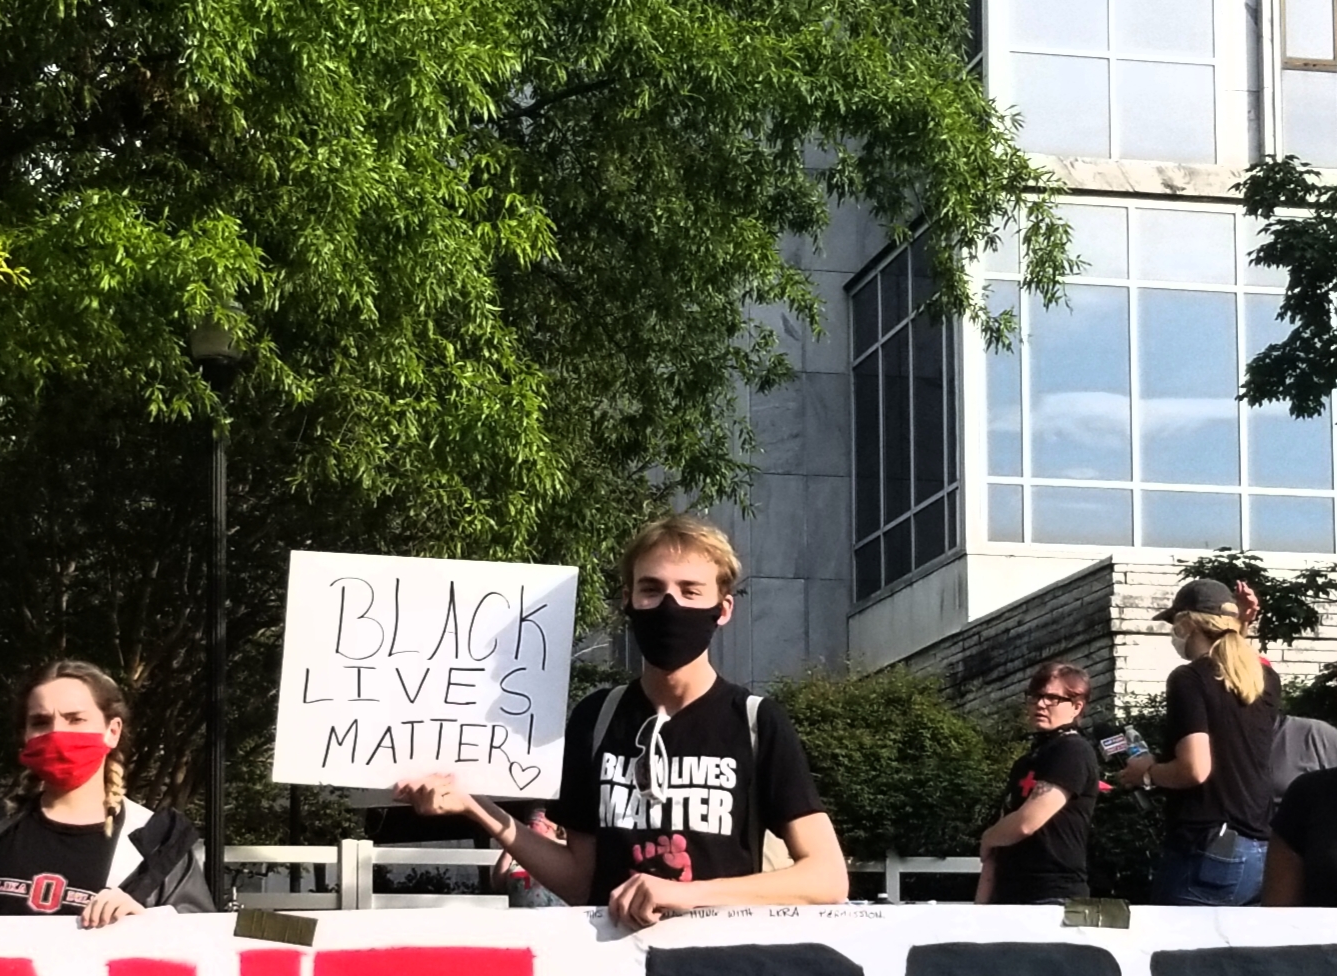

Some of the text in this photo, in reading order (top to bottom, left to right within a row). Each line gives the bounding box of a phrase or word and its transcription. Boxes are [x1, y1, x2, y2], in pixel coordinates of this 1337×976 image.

[330, 577, 549, 671] BLACK
[302, 666, 533, 715] LIVES
[669, 755, 737, 789] LIVES
[599, 783, 734, 836] MATTER
[28, 872, 68, 913] O
[727, 908, 754, 918] WITH
